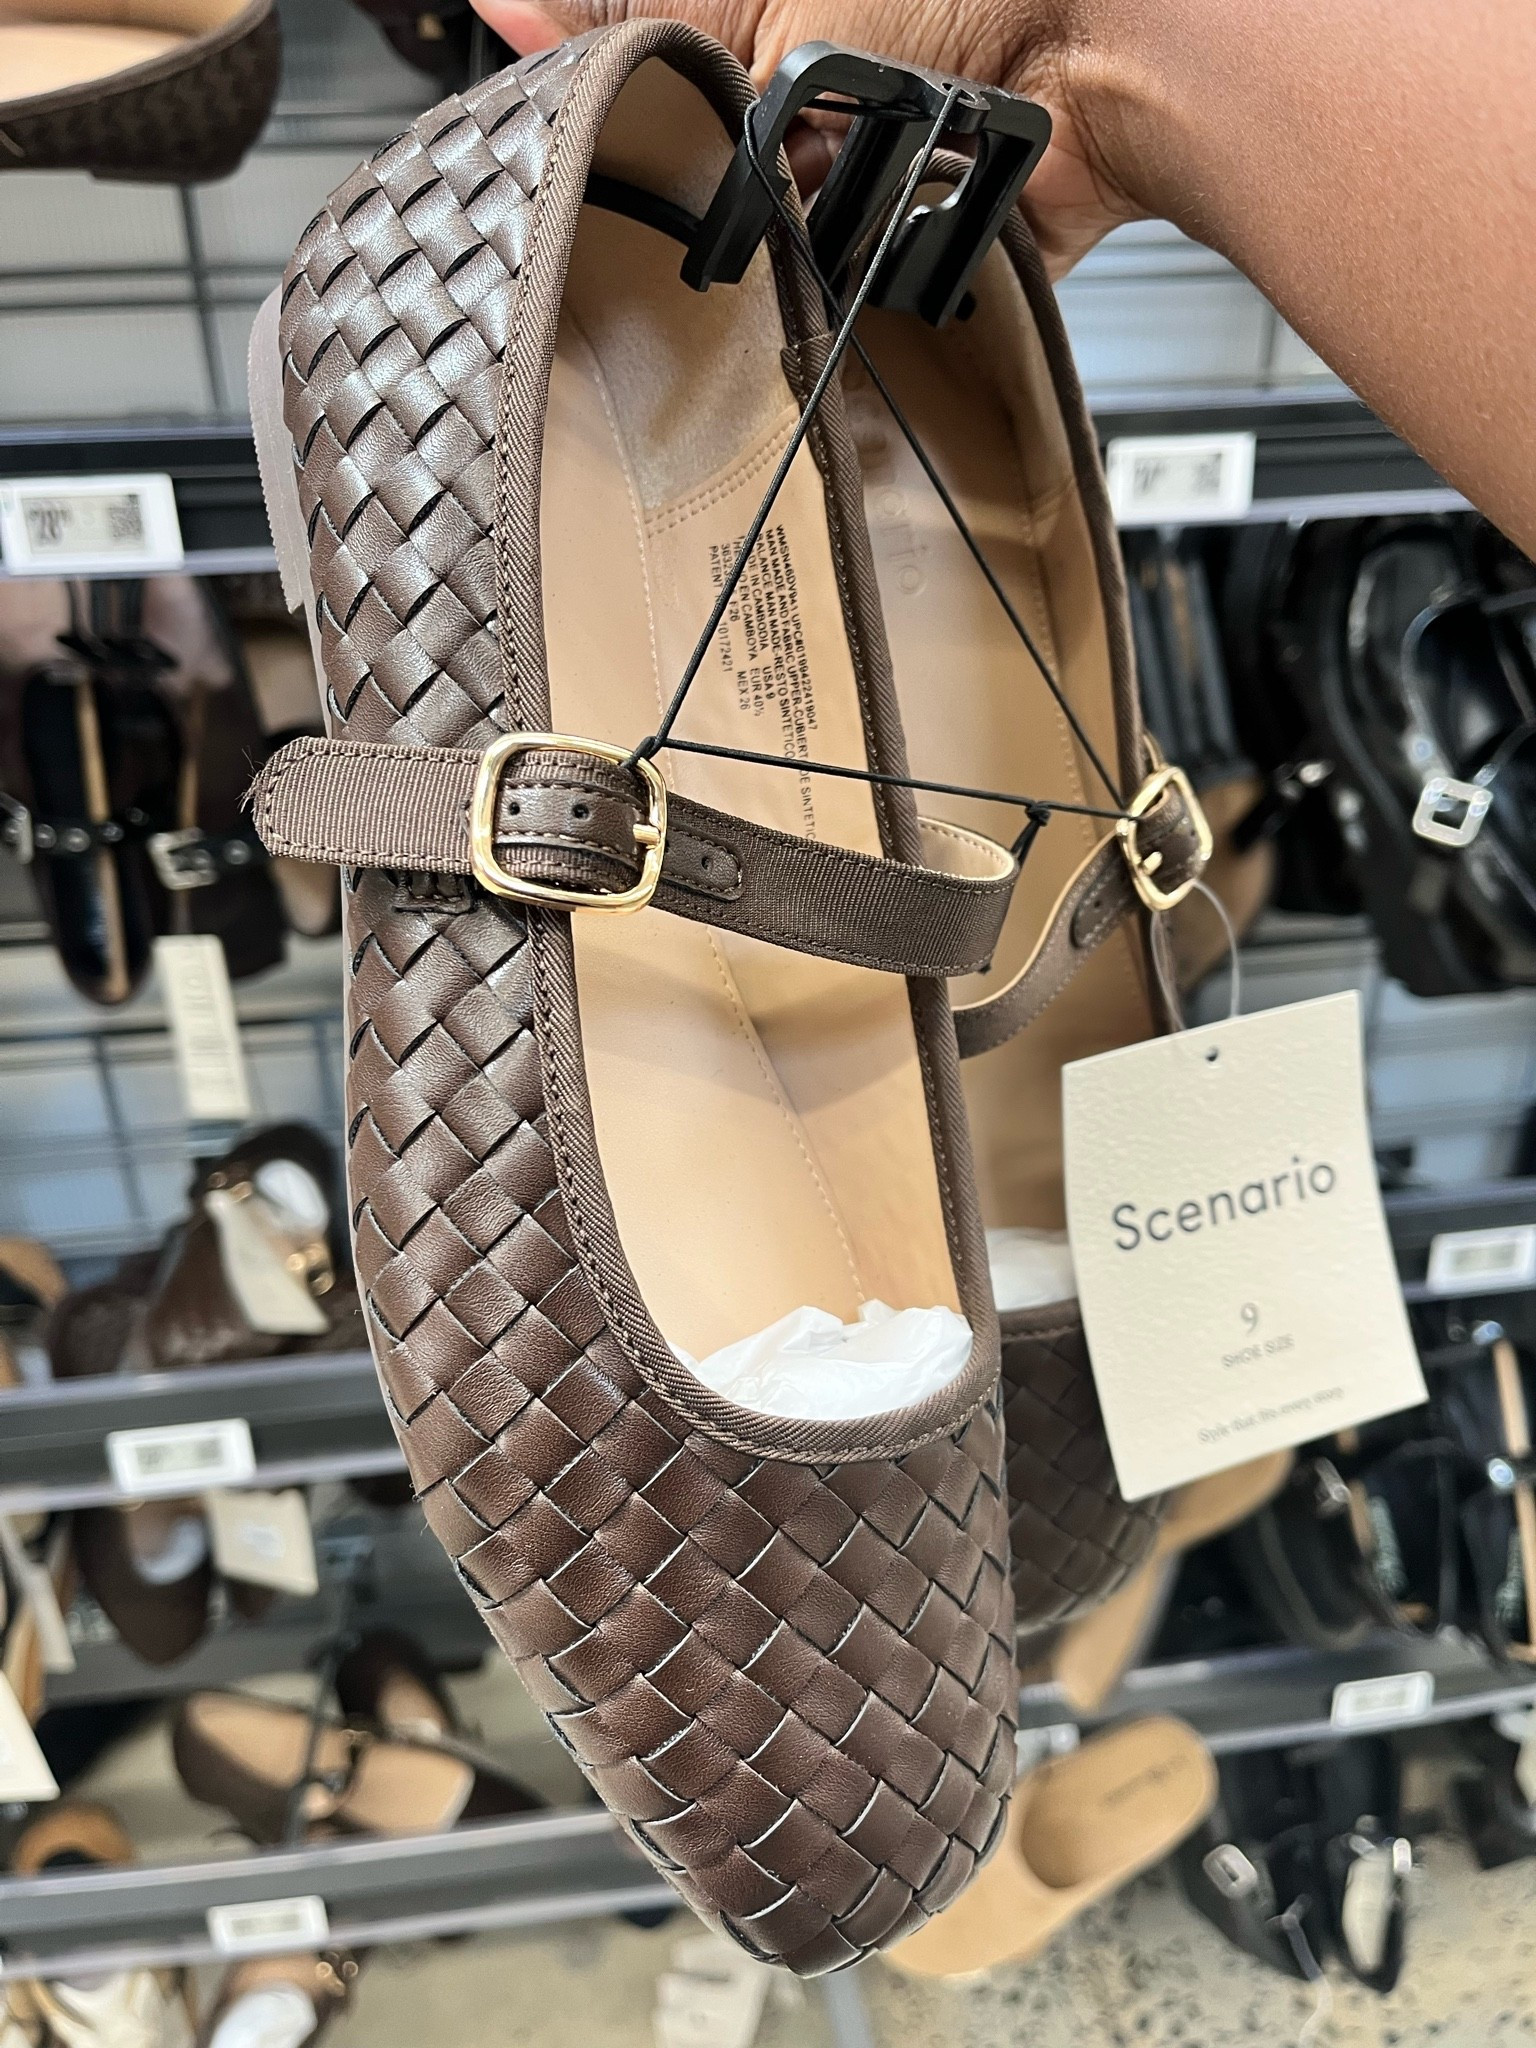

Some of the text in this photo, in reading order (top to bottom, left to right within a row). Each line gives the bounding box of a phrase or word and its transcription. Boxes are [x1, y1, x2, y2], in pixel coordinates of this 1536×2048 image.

[765, 529, 777, 556] MAN
[708, 544, 722, 588] PATENT
[749, 573, 759, 586] IN
[771, 557, 784, 591] MADE
[739, 585, 749, 601] EN
[778, 593, 788, 618] AND
[742, 603, 757, 661] CAMBOYA
[752, 587, 768, 650] CAMBODIA
[781, 619, 795, 663] FABRIC
[736, 669, 750, 711] MEX 26
[749, 667, 762, 692] EUR
[762, 665, 775, 700] USA 9
[765, 590, 777, 617] MAN
[779, 697, 795, 759] SINTETICO
[787, 665, 809, 761] UPPER-CUBIERT
[800, 786, 816, 840] SINTETIC
[1112, 1156, 1337, 1250] Scenario
[1241, 1302, 1258, 1335] 9
